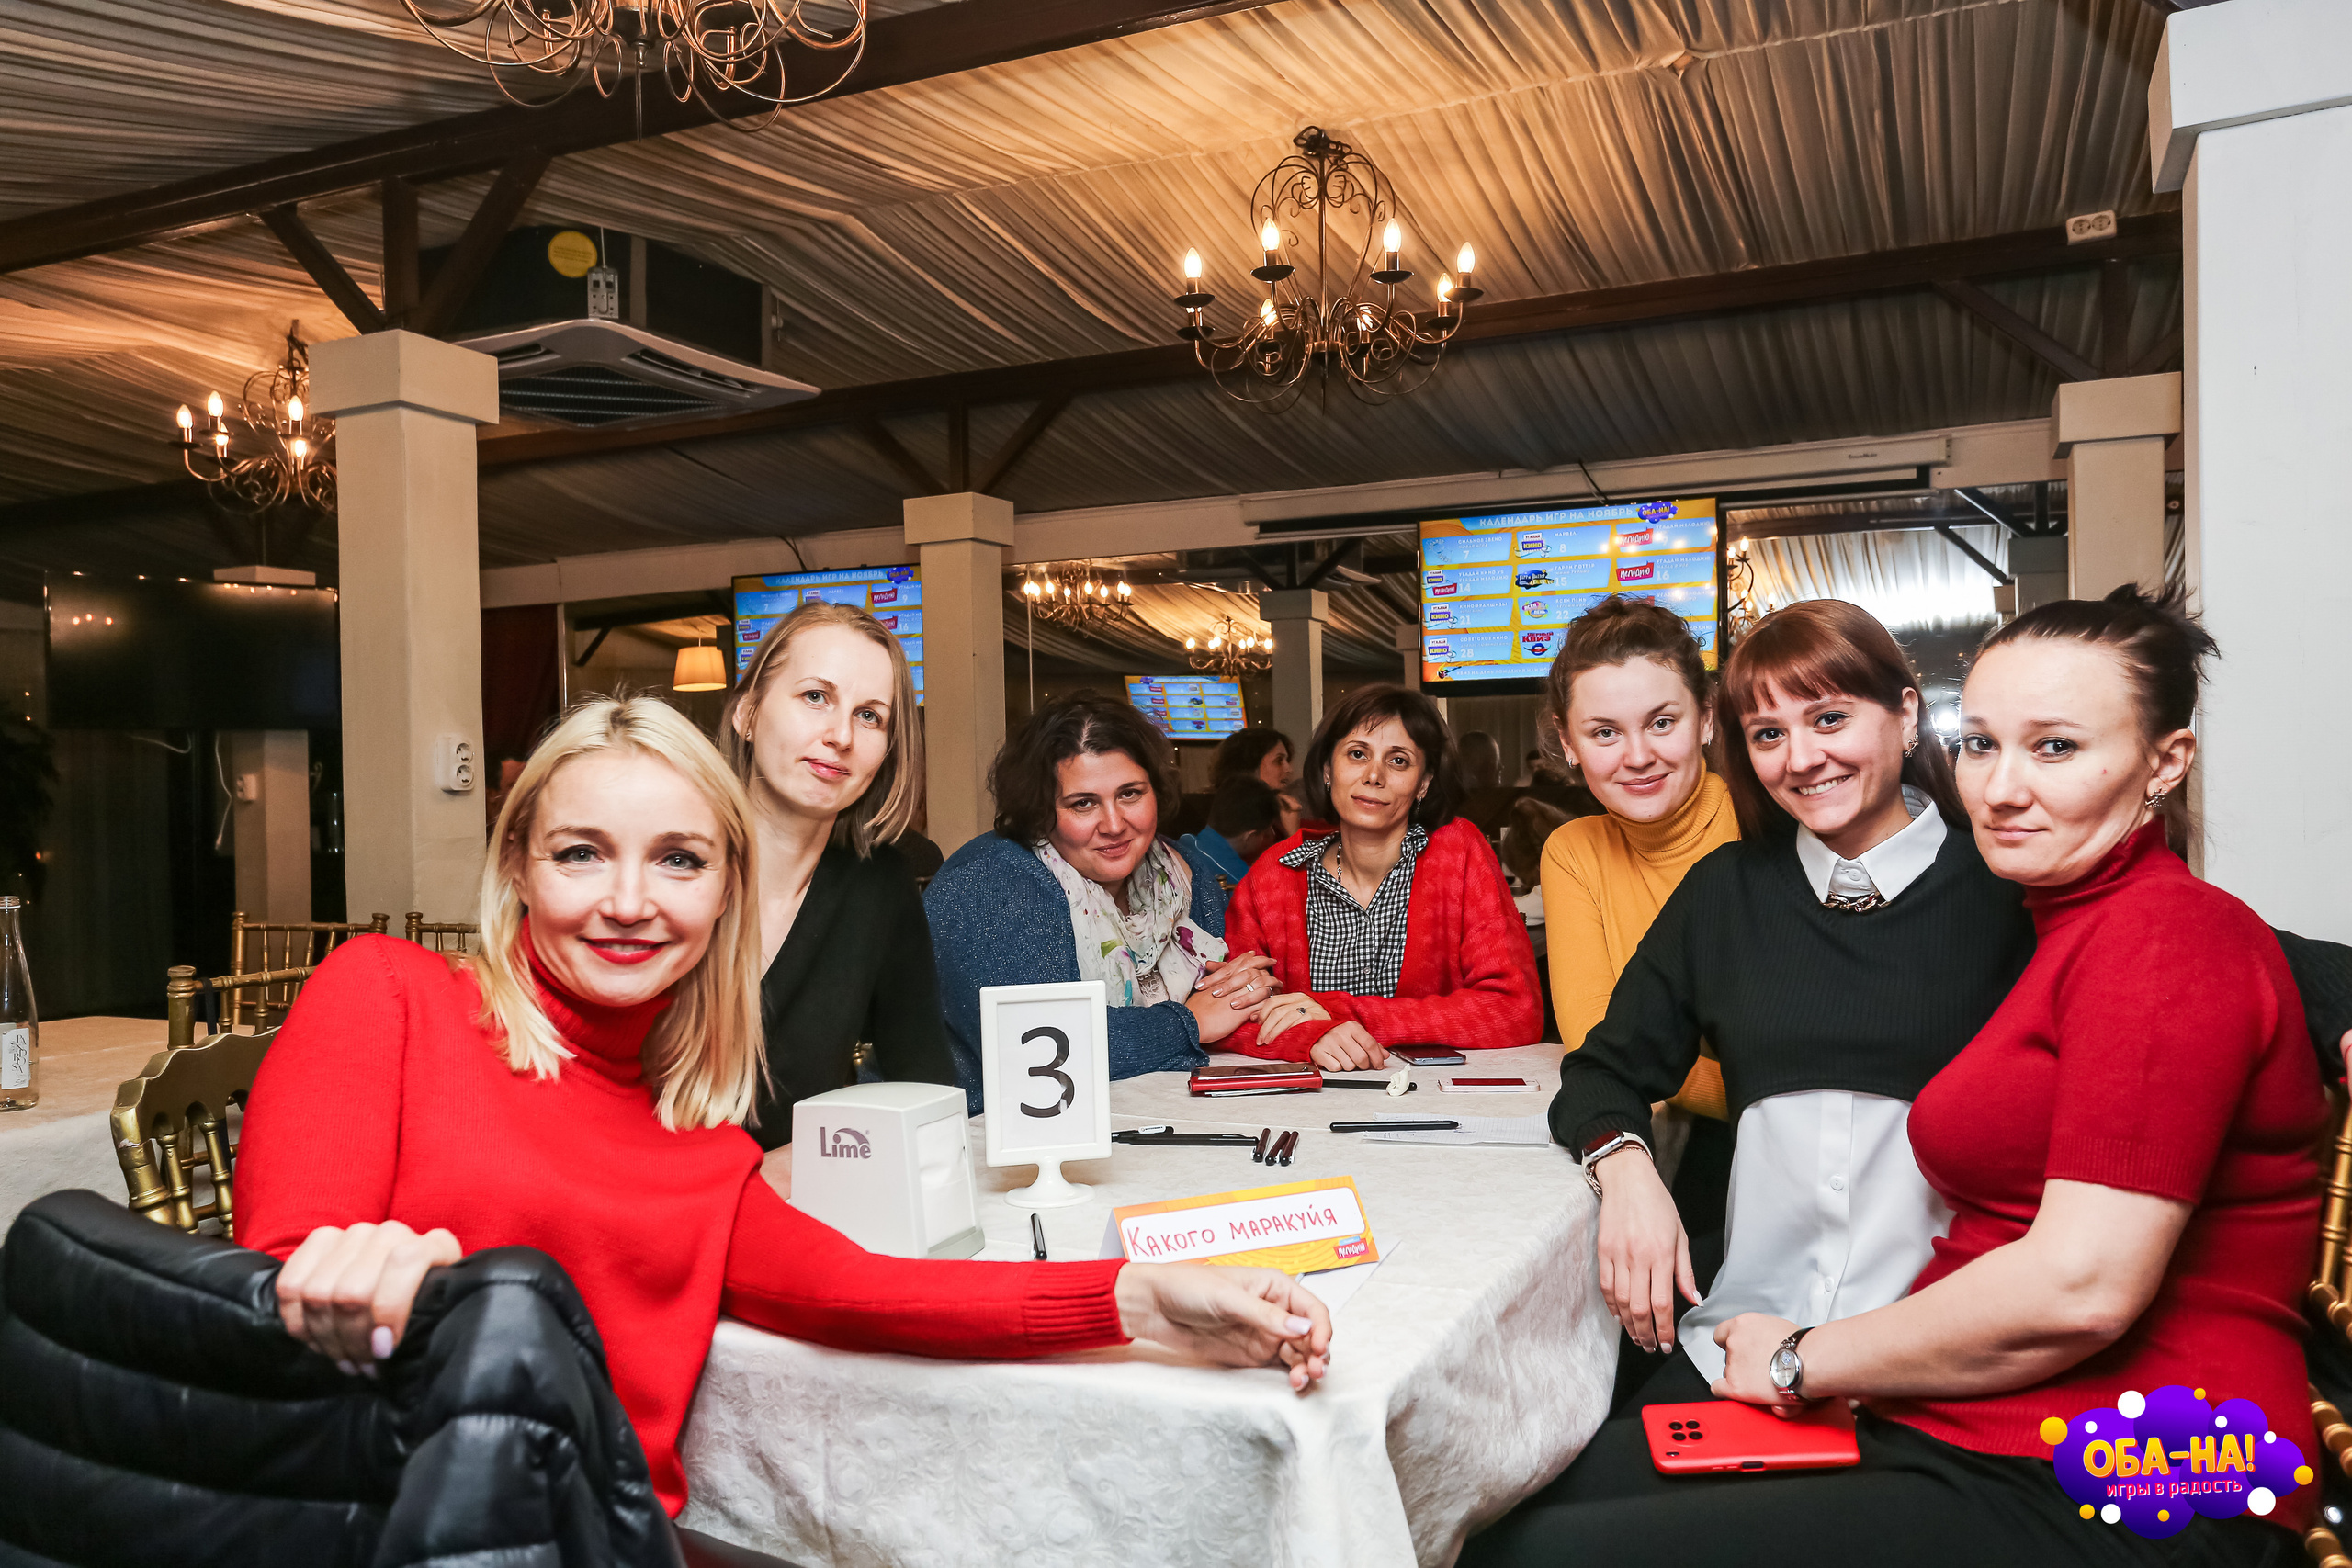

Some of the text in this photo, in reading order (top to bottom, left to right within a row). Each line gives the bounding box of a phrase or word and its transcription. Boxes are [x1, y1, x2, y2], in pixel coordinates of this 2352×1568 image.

[1479, 507, 1633, 527] КАЛЕНДАРЬ ИГР НА НОЯБРЬ
[1559, 543, 1566, 553] 8
[1463, 550, 1469, 559] 7
[775, 574, 820, 584] КАЛЕНДАРЬ
[838, 570, 850, 580] НА
[851, 570, 884, 580] НОЯБРЬ
[1657, 570, 1670, 581] 16
[1555, 577, 1567, 586] 15
[1459, 582, 1471, 592] 14
[902, 594, 908, 604] 9
[1460, 615, 1471, 625] 21
[1555, 610, 1569, 620] 22
[1461, 649, 1475, 658] 28
[1020, 1026, 1075, 1119] 3
[820, 1126, 872, 1159] Lime
